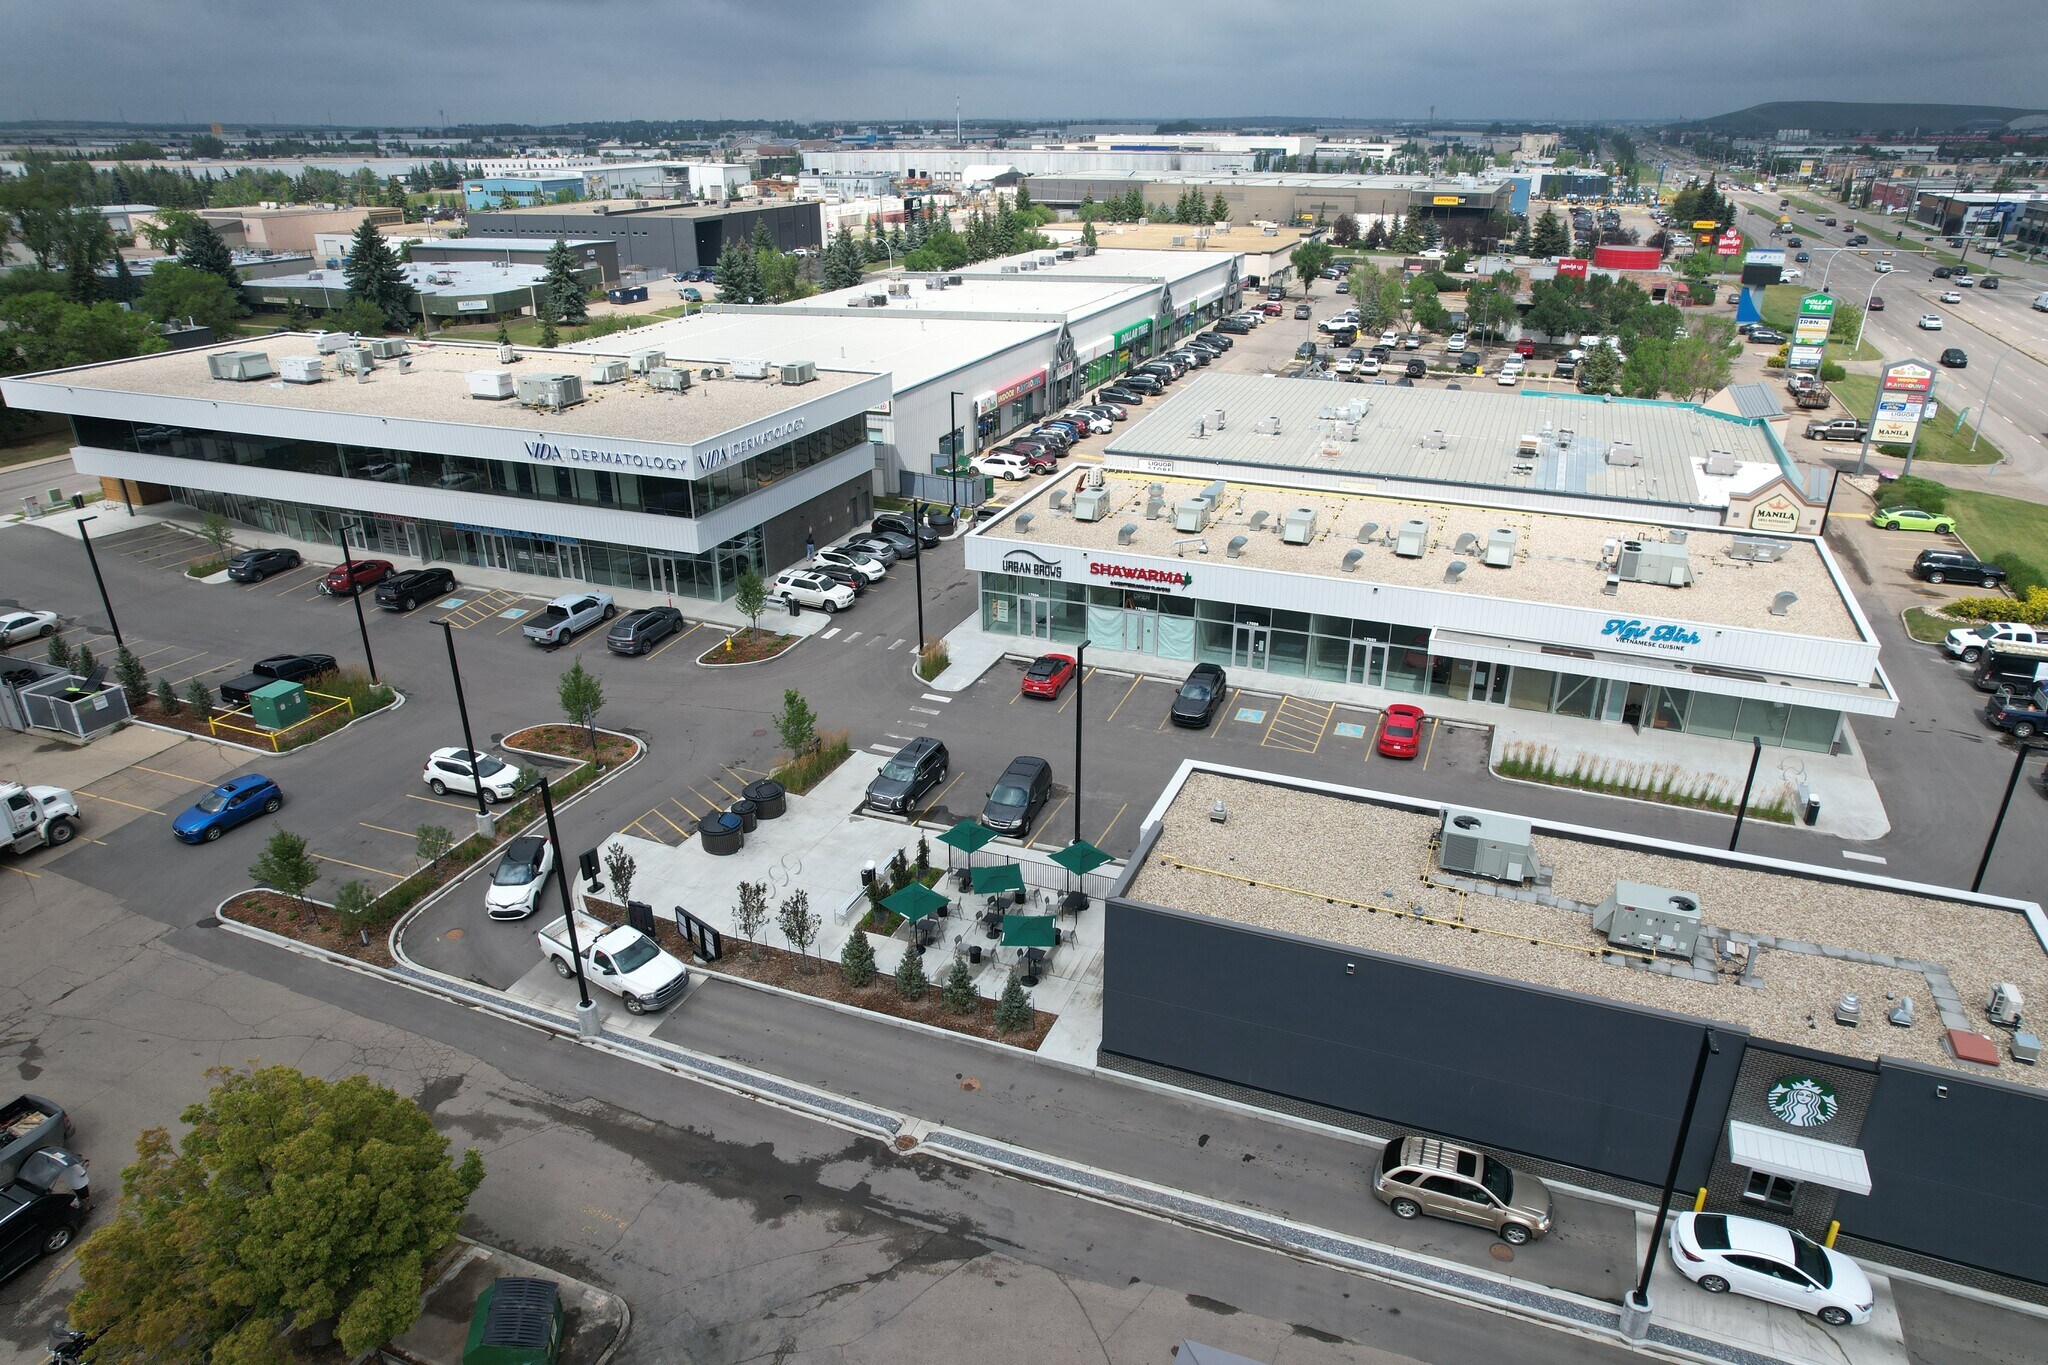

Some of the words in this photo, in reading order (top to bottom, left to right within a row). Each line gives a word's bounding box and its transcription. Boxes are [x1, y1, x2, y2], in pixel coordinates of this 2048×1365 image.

[1121, 328, 1137, 344] DOLLAR
[1138, 322, 1149, 336] TREE
[1878, 429, 1909, 437] MANILA
[697, 446, 727, 471] VIDA
[732, 417, 805, 456] DERMATOLOGY
[524, 440, 564, 462] VIDA
[570, 448, 687, 471] DERMATOLOGY
[1757, 510, 1795, 520] MANILA
[1002, 559, 1031, 575] URBAN
[1033, 563, 1062, 578] BROWS
[1090, 562, 1185, 585] SHAWARMA
[1133, 593, 1151, 601] OPEN
[1615, 637, 1656, 648] VIETNAMESE
[1658, 642, 1685, 652] CUISINE
